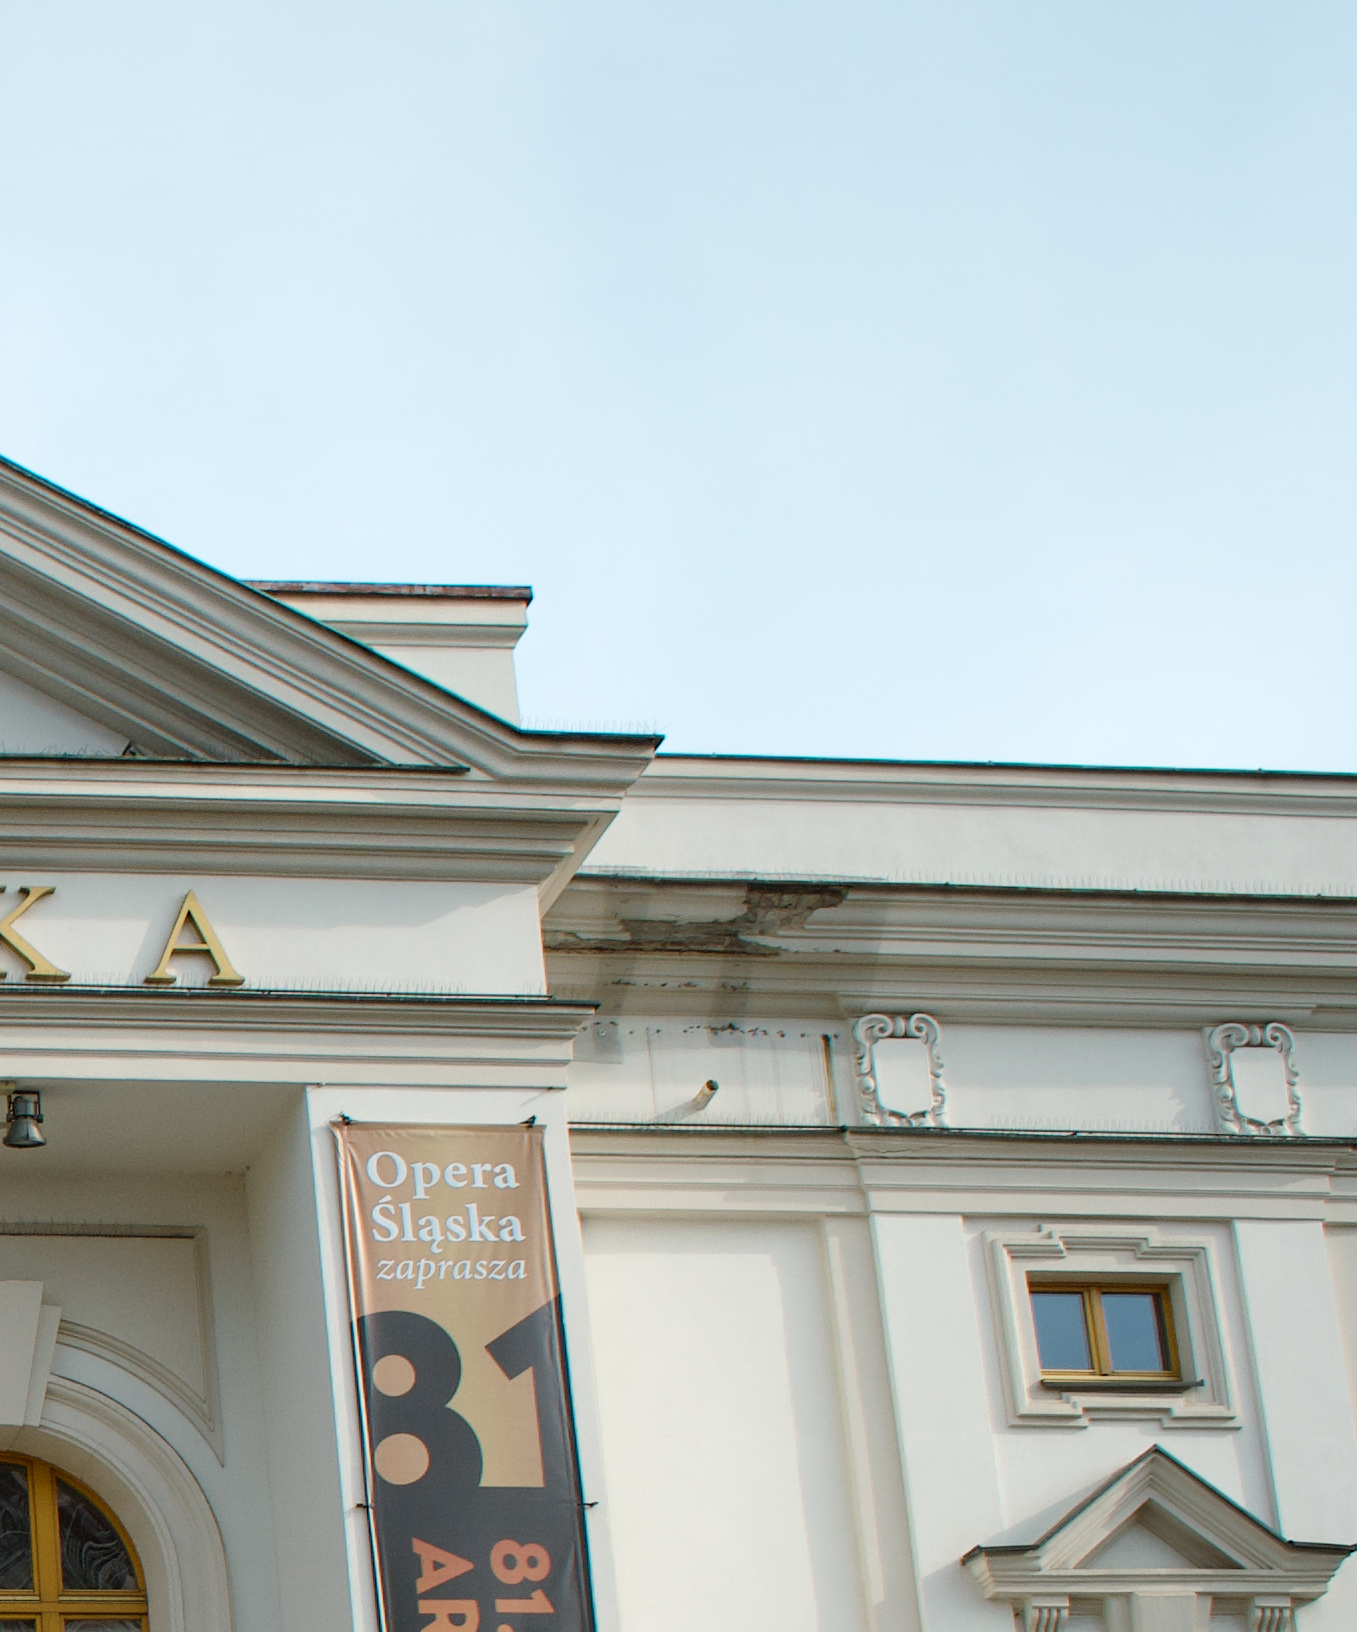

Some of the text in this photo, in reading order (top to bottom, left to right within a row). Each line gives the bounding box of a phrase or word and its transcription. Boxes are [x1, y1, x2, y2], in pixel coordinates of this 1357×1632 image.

[366, 1151, 520, 1200] Opera
[371, 1195, 526, 1253] Śląska
[376, 1256, 528, 1290] zaprasza
[351, 1293, 579, 1488] 81
